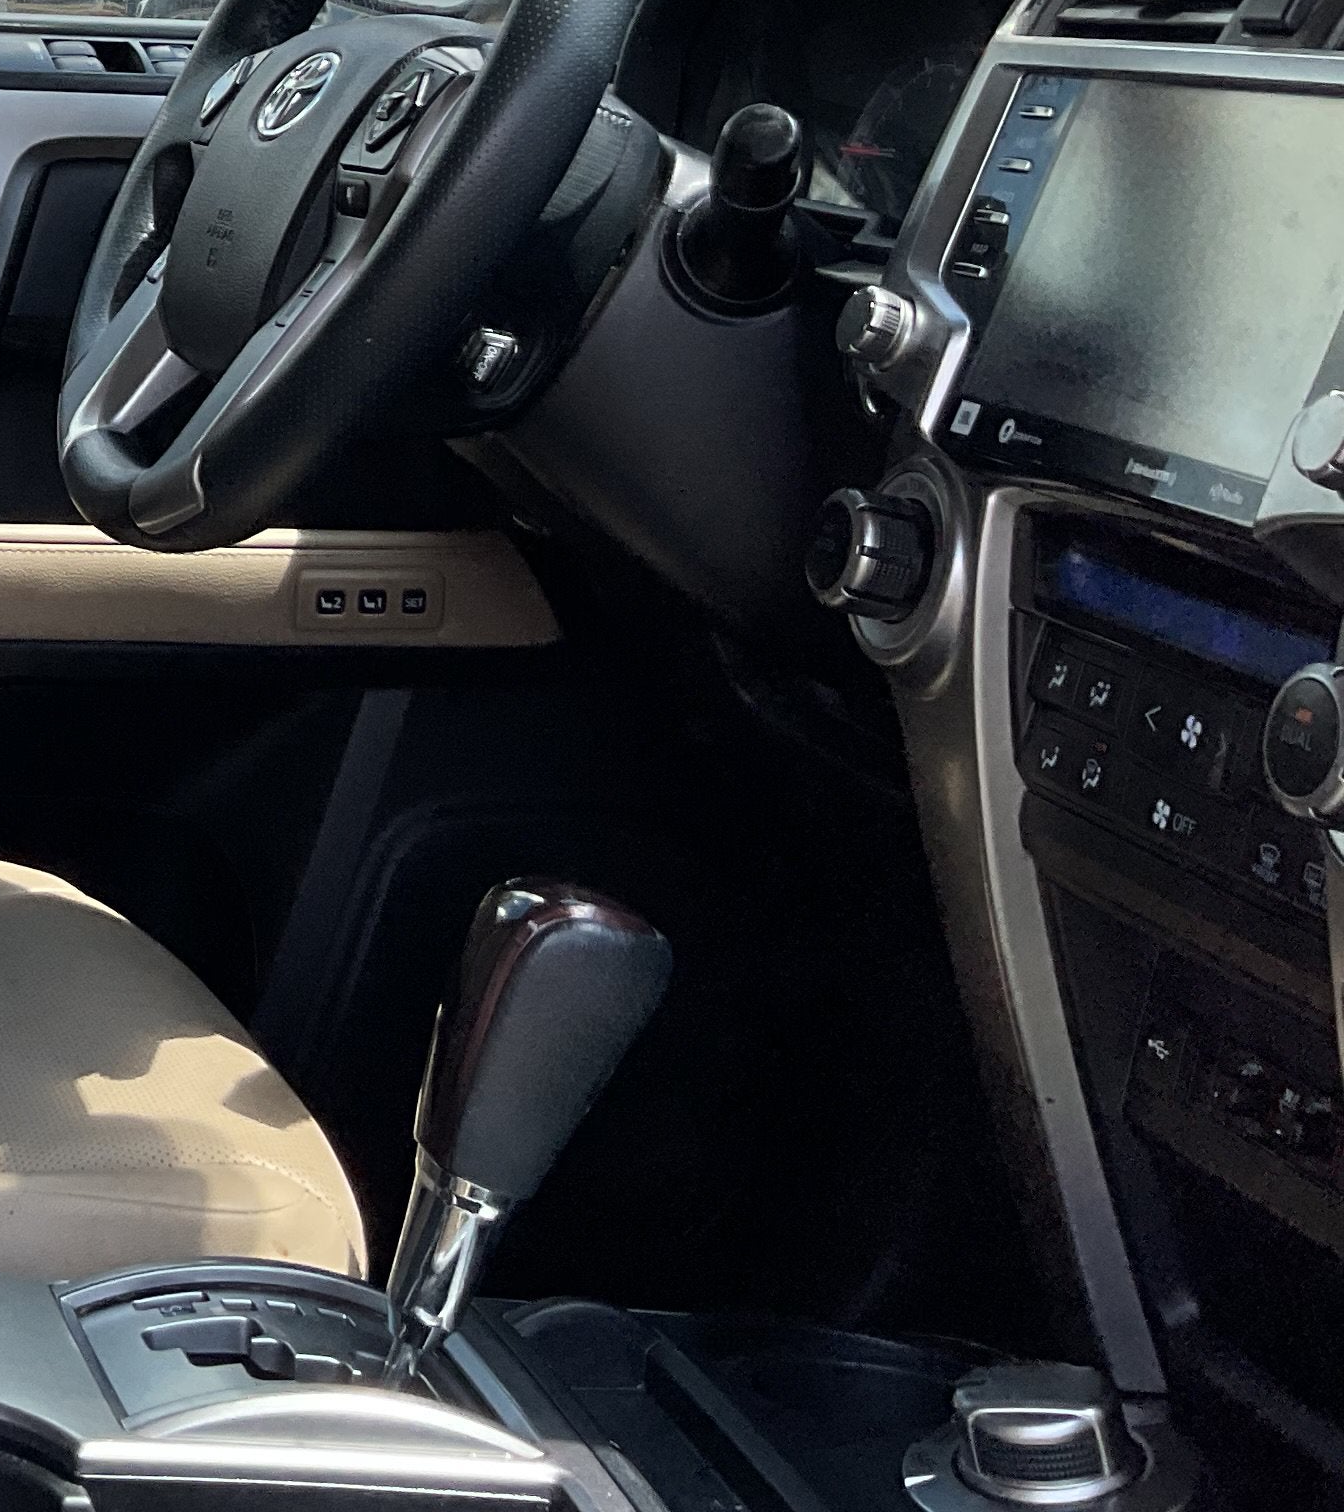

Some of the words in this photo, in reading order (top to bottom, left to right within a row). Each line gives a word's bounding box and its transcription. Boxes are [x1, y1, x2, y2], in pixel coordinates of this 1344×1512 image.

[333, 596, 342, 609] 2
[404, 596, 424, 608] SET
[1172, 812, 1198, 836] OFF
